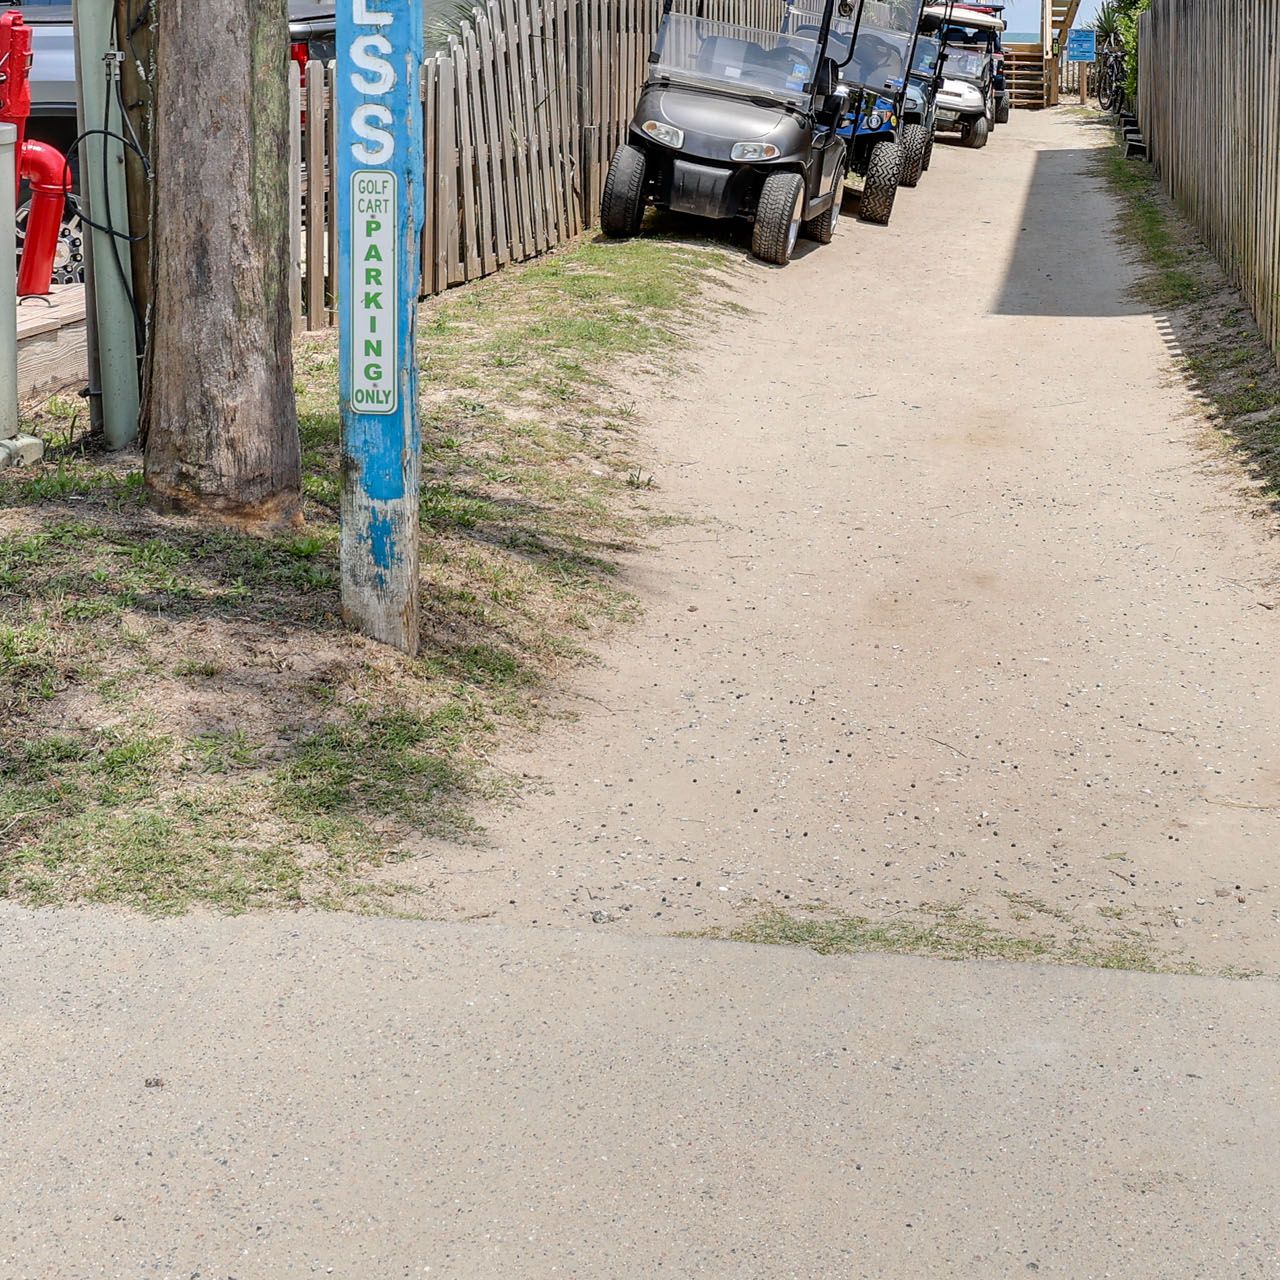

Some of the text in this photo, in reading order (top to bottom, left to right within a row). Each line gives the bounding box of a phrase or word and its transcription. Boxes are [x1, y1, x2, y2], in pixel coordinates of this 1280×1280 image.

[358, 179, 389, 195] GOLF
[357, 198, 390, 214] CART
[363, 219, 384, 382] PARKING
[354, 388, 392, 405] ONLY
